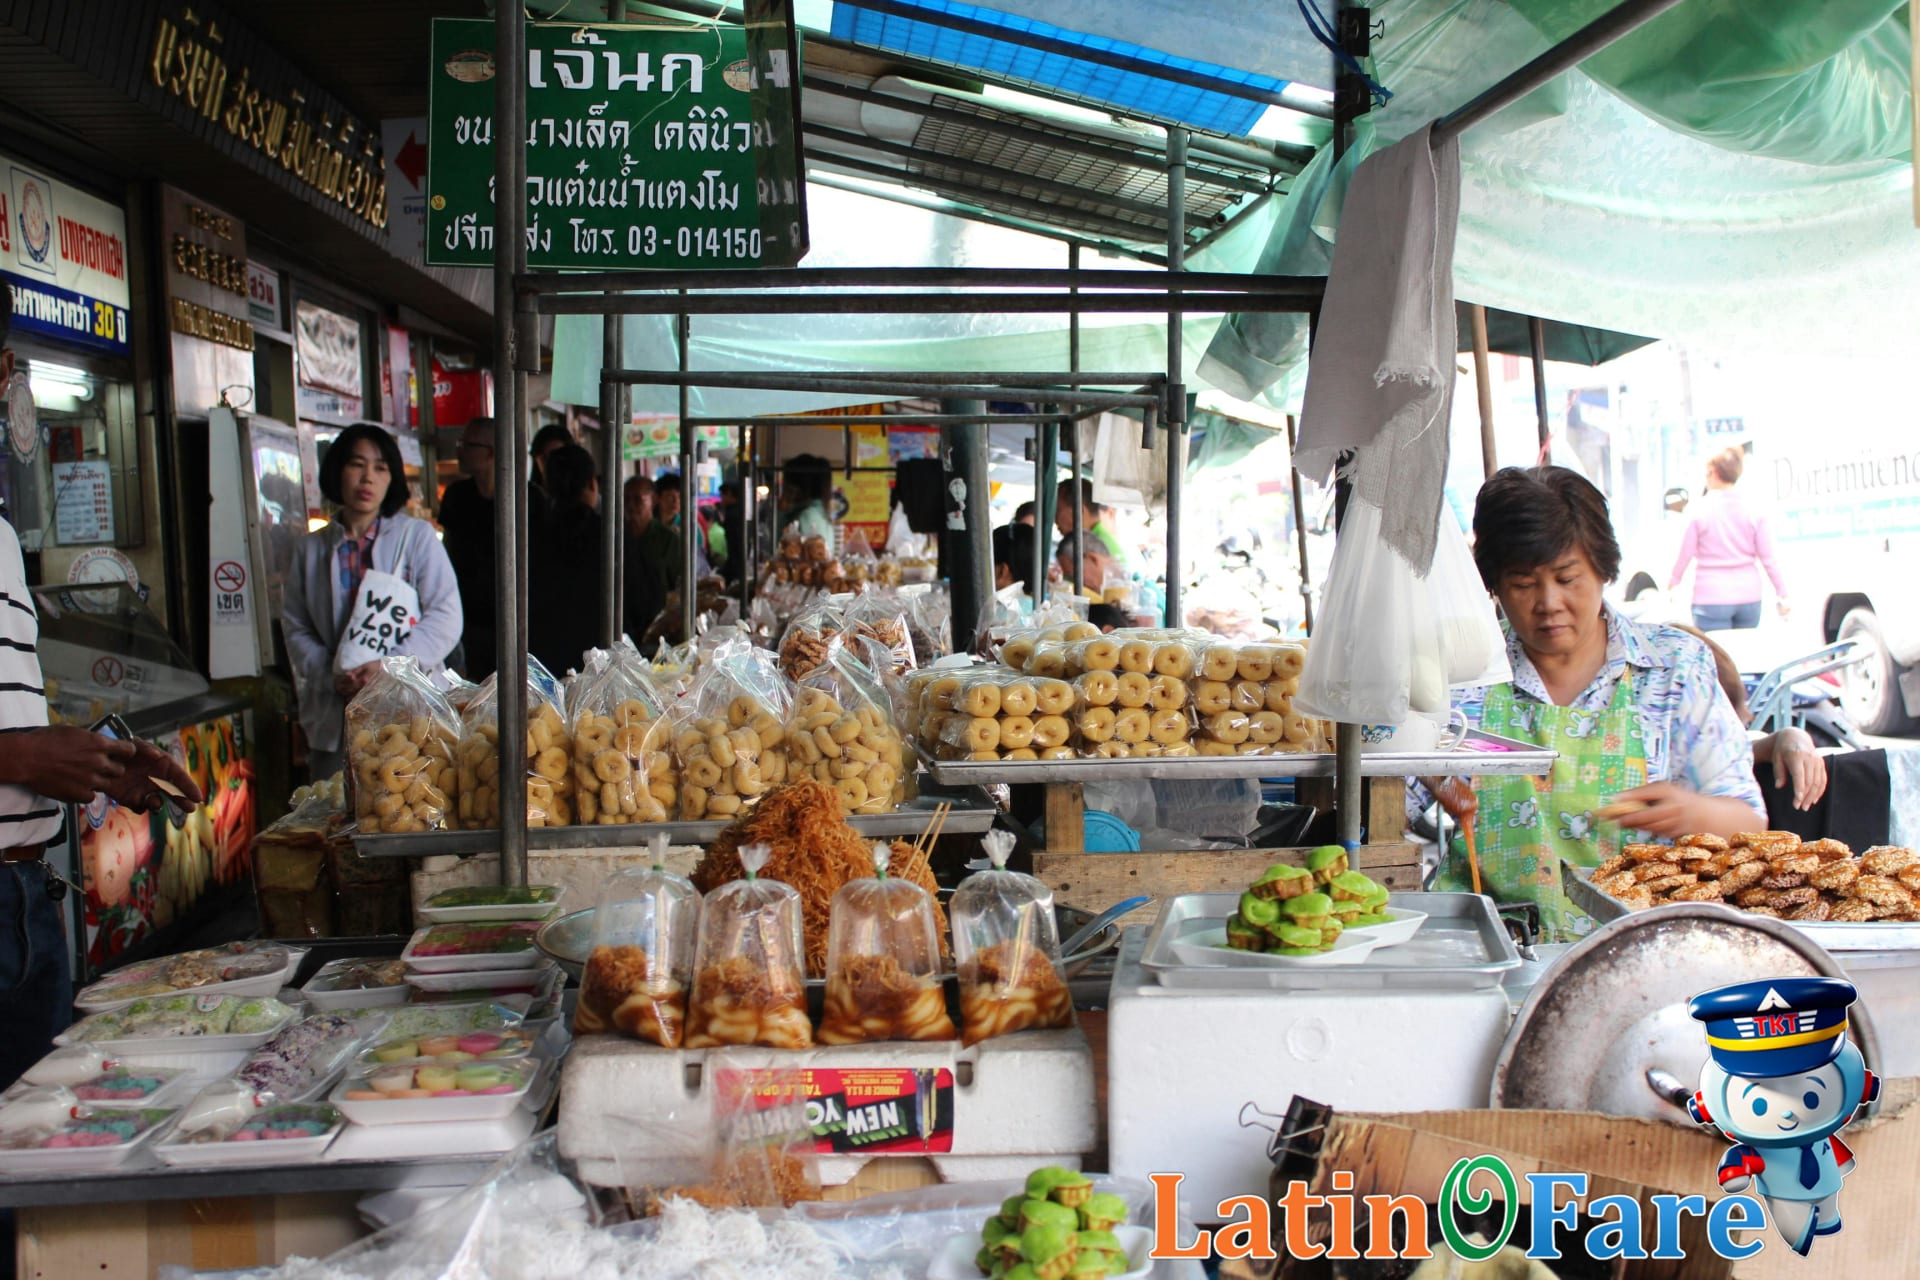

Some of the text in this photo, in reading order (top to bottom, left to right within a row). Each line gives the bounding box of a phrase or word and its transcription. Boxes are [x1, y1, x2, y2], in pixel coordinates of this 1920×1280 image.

[529, 32, 703, 93] เจ๊นก
[57, 215, 124, 281] บางกอกแฮม
[569, 218, 618, 255] โทร.
[628, 225, 762, 259] 03-014150
[94, 300, 115, 340] 30
[366, 590, 407, 624] We
[349, 628, 390, 656] Vich
[361, 613, 411, 645] Lov
[846, 1101, 900, 1136] NEW
